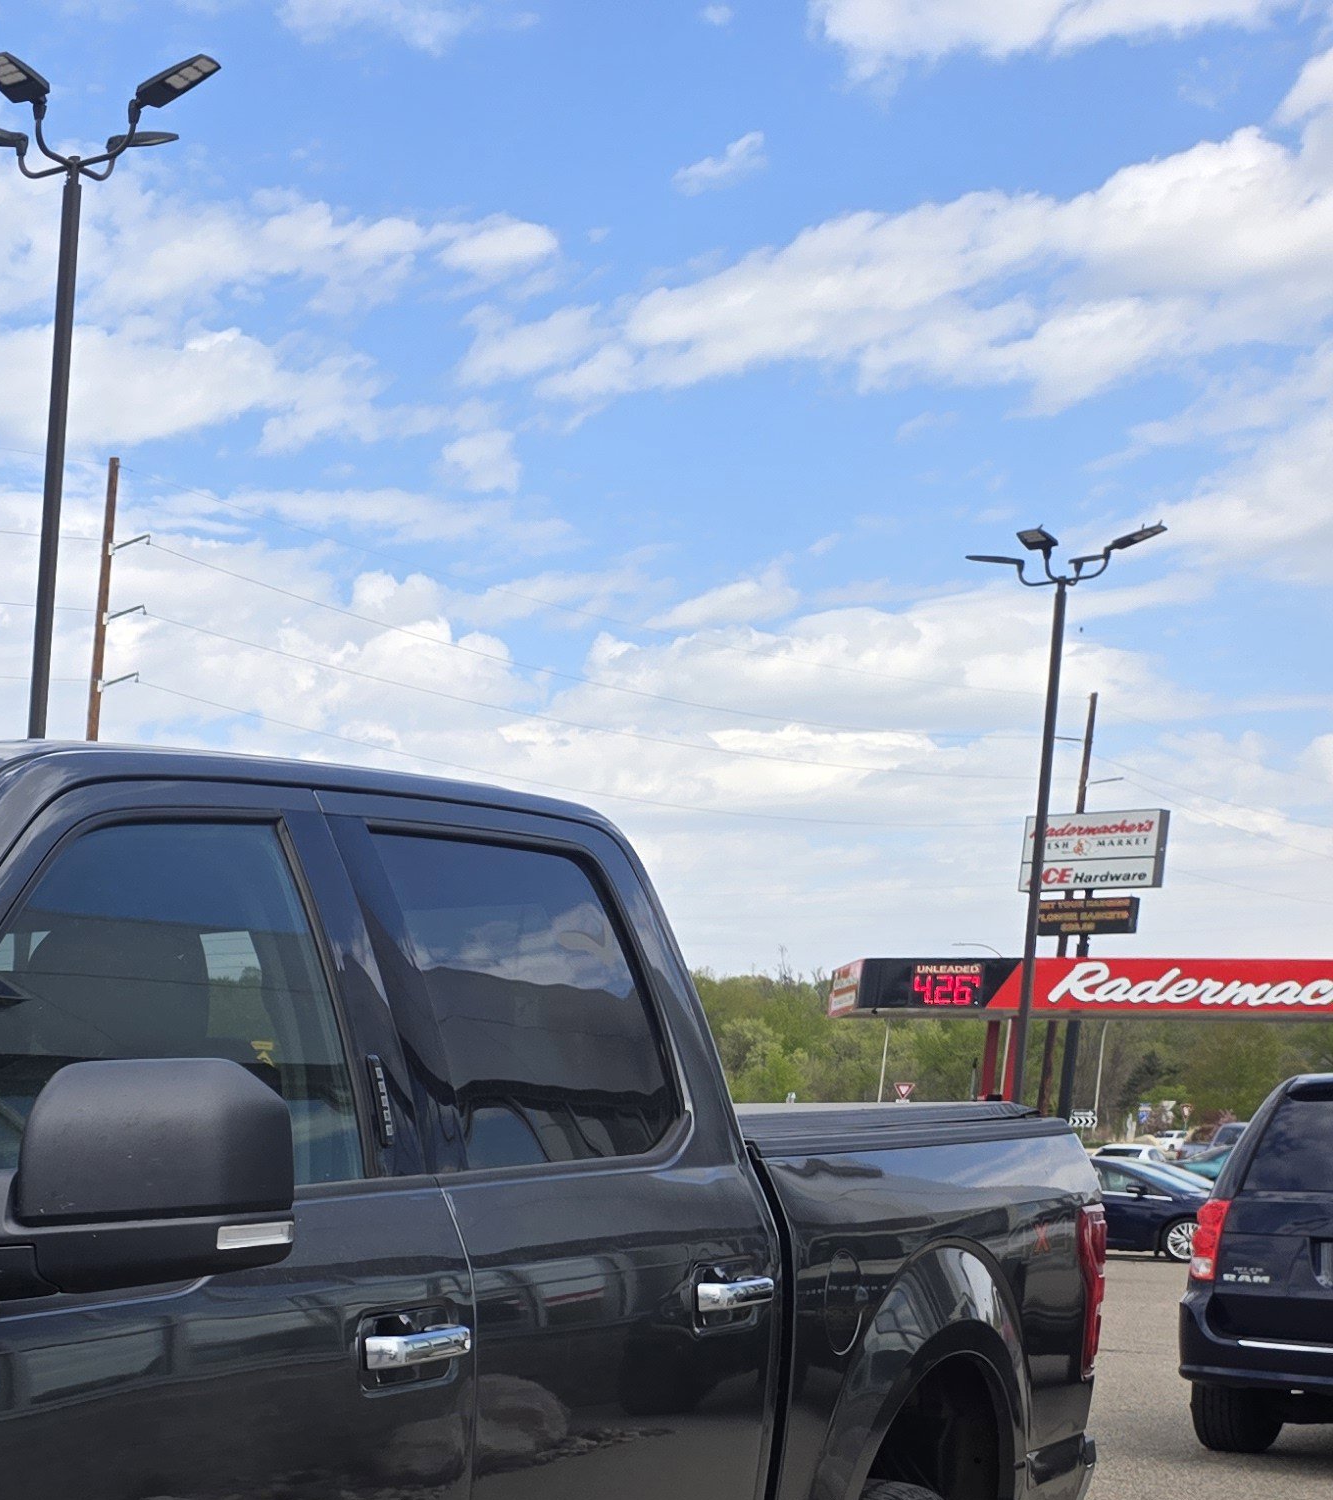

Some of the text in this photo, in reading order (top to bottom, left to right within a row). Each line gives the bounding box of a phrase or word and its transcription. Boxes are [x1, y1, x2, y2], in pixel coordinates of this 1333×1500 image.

[1096, 837, 1149, 847] MARKET
[1025, 867, 1147, 886] CE Hardware
[916, 964, 980, 974] UNLEADED
[1222, 1273, 1271, 1284] RAM
